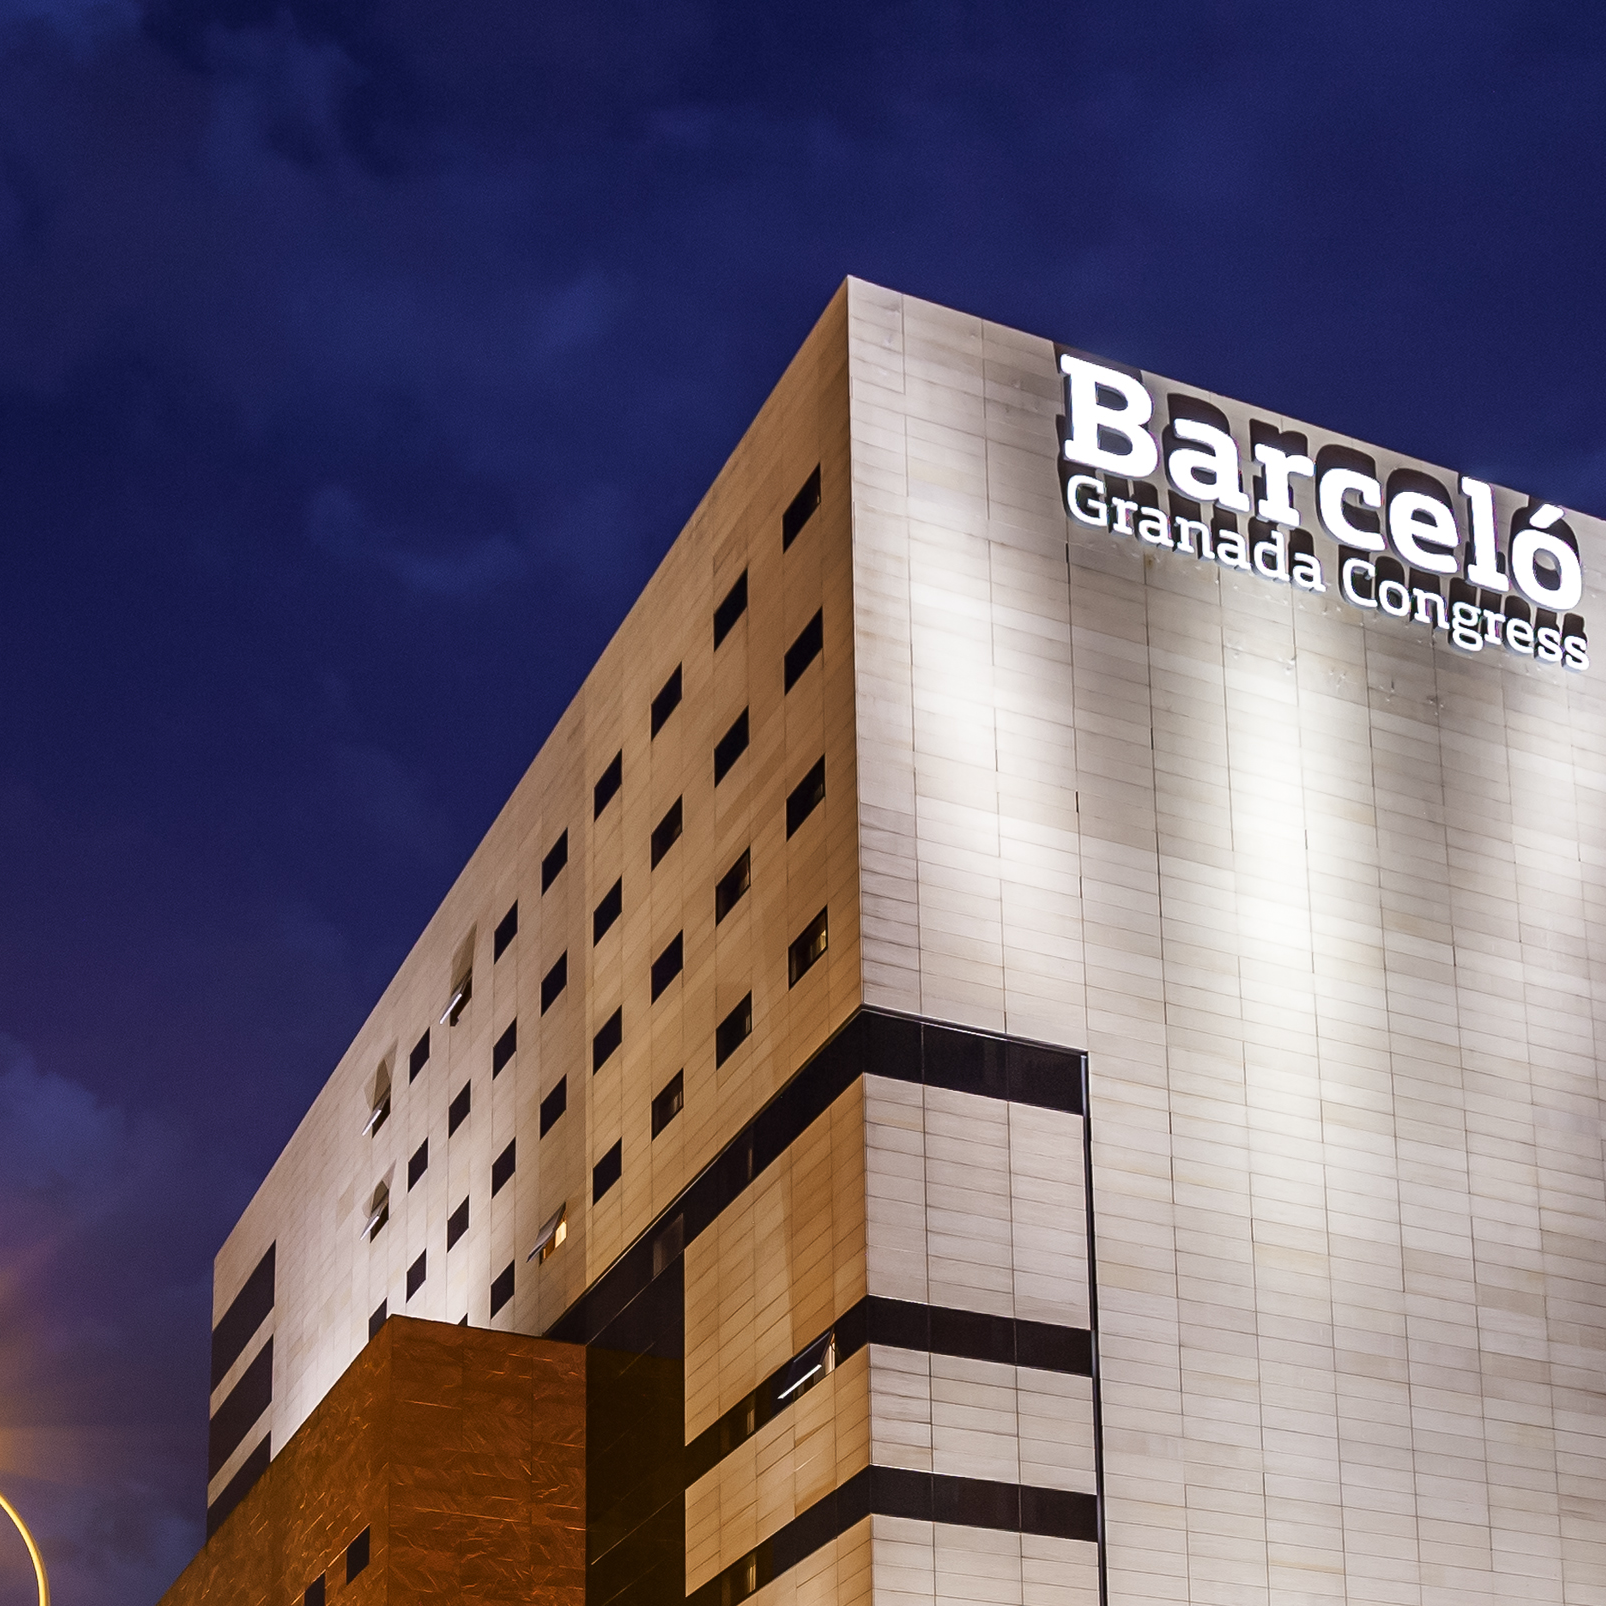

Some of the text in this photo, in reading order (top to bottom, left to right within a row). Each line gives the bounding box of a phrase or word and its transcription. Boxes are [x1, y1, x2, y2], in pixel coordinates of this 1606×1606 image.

[1061, 354, 1582, 610] Barceló
[1067, 475, 1589, 673] Granada Congress
